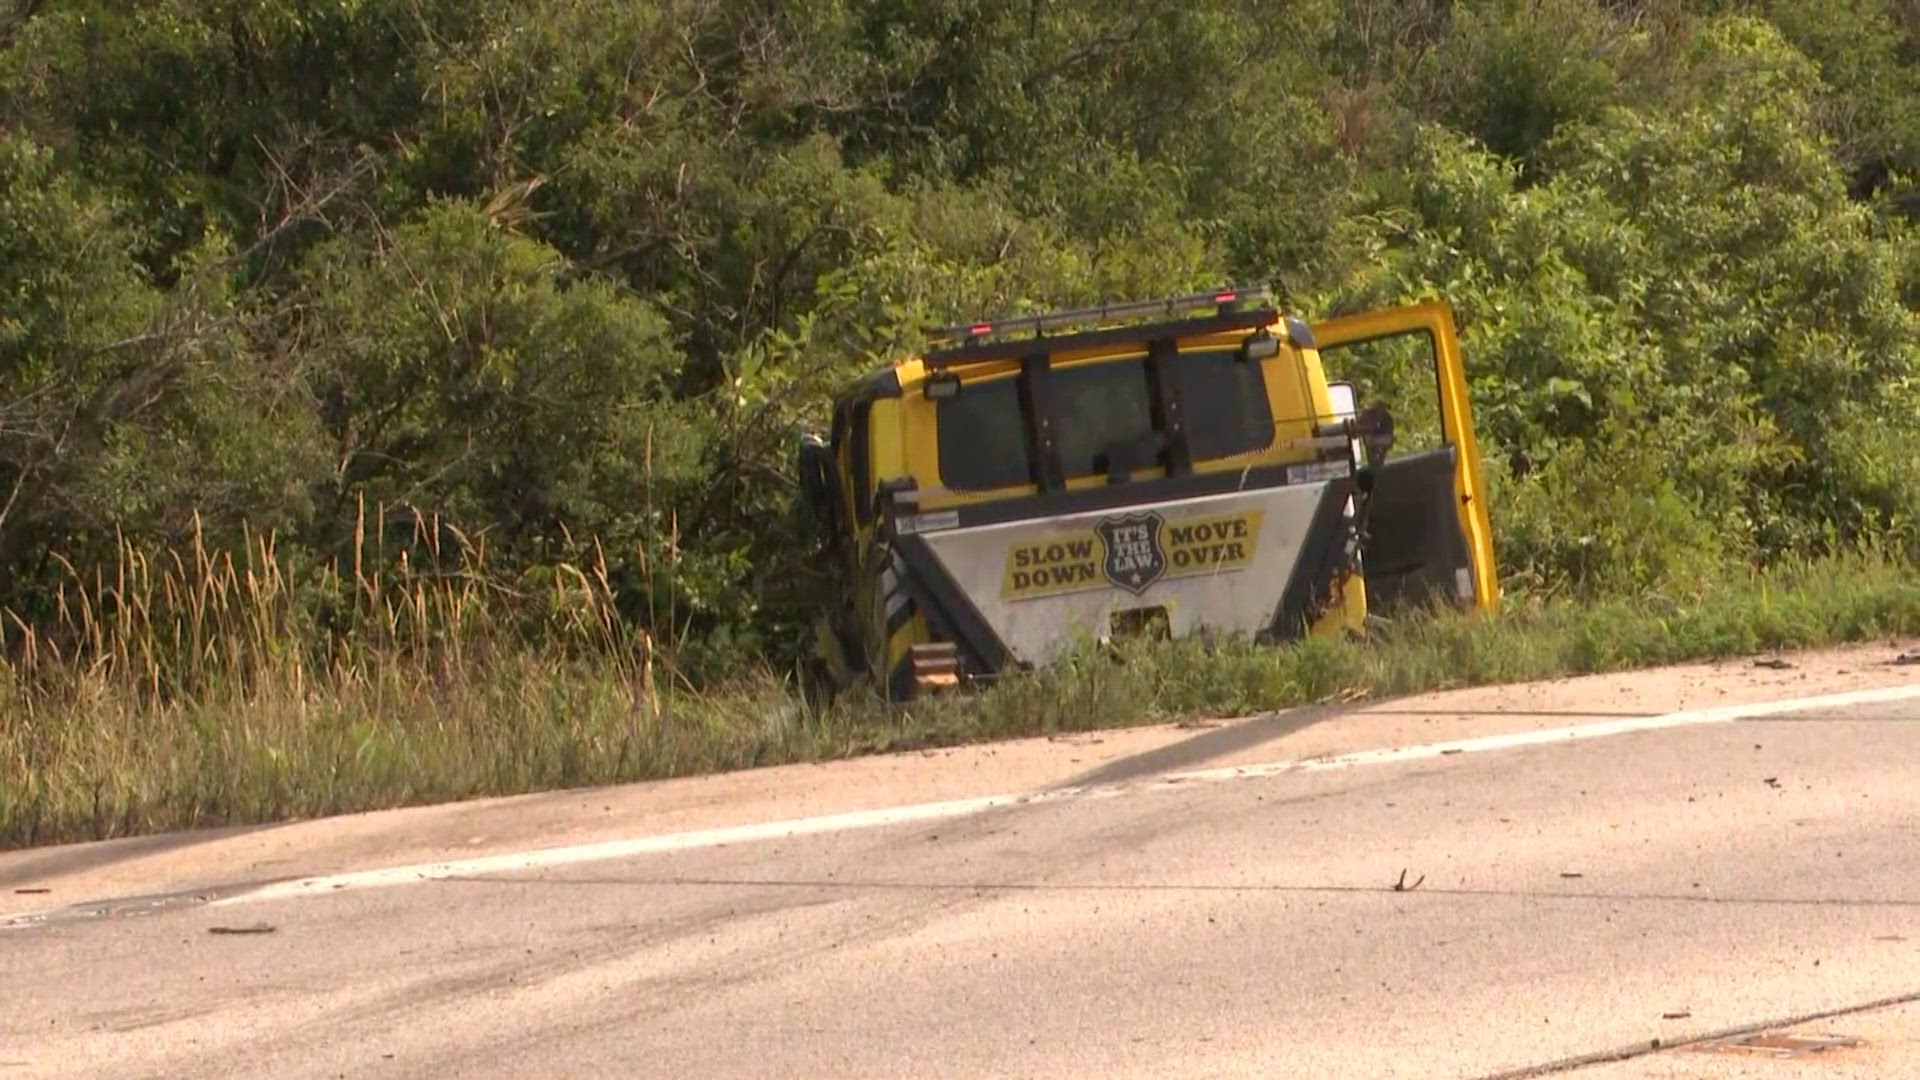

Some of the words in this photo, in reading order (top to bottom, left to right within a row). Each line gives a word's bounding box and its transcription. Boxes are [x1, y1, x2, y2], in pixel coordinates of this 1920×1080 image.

[1113, 524, 1149, 542] IT'S
[1170, 519, 1248, 546] MOVE
[1015, 539, 1094, 567] SLOW
[1115, 540, 1151, 557] THE
[1172, 542, 1245, 567] OVER
[1012, 562, 1095, 590] DOWN
